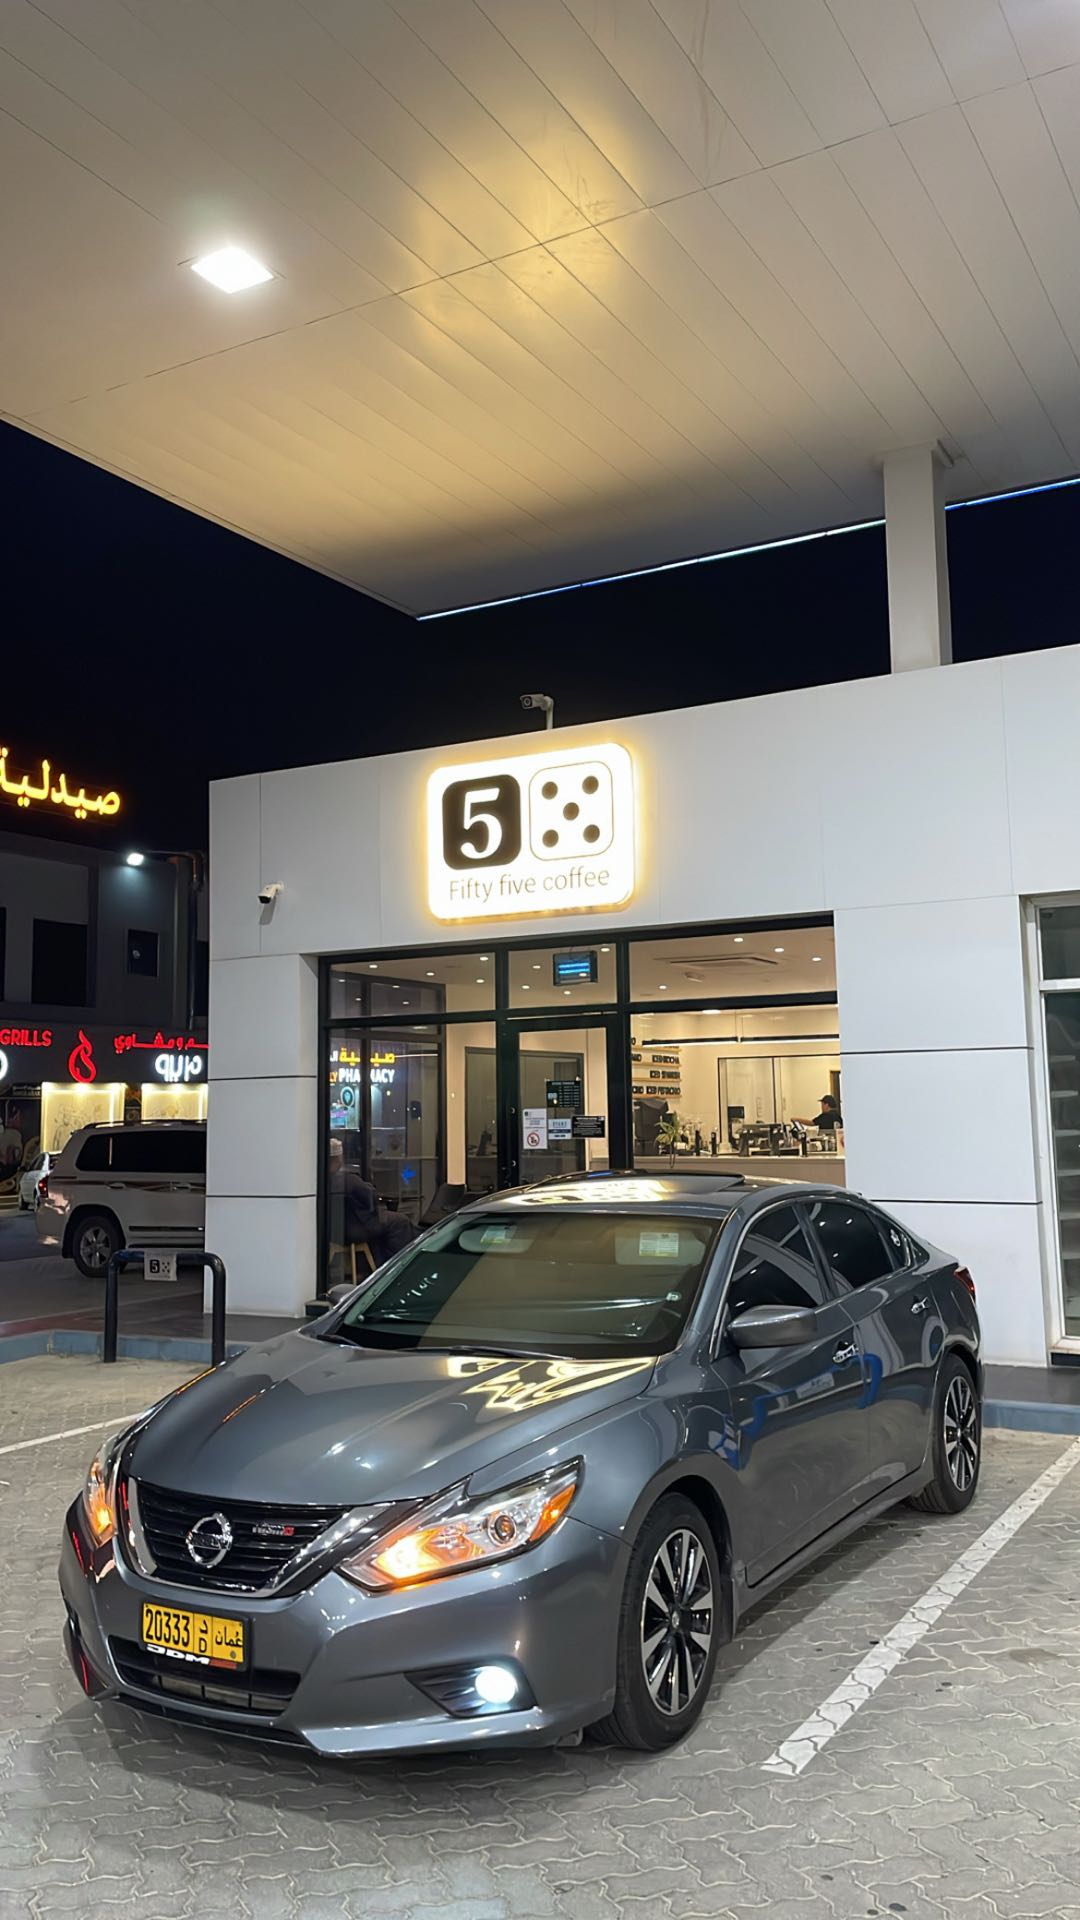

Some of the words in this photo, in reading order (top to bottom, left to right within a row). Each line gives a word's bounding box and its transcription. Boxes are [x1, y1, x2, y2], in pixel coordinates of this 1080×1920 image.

[460, 787, 503, 860] 5
[449, 878, 493, 904] Fifty
[499, 873, 536, 897] five
[542, 866, 610, 892] coffee
[0, 1028, 52, 1047] GRILLS
[339, 1046, 396, 1068] صيية
[338, 1067, 396, 1084] PHAACY
[145, 1608, 190, 1648] 20333
[199, 1637, 208, 1654] D
